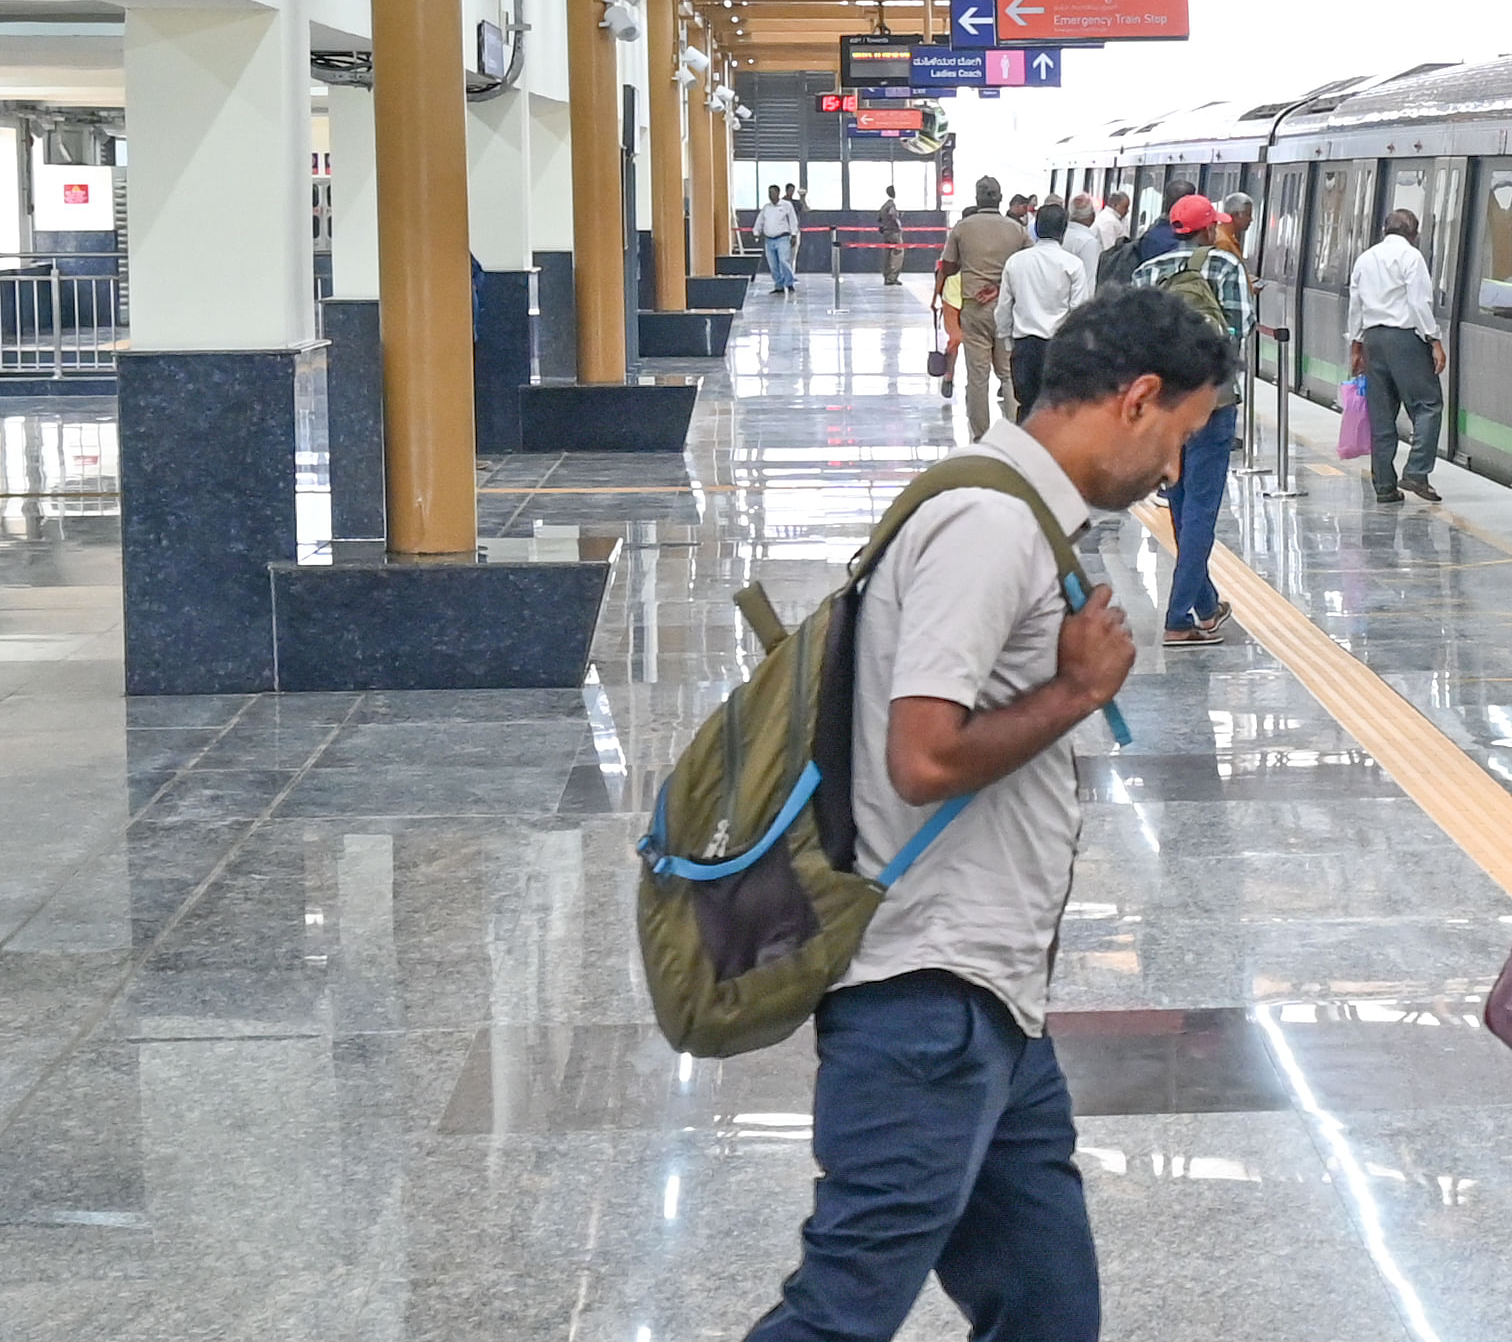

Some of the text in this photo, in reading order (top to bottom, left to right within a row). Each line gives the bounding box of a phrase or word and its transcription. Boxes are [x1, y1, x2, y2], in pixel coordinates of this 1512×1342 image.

[1054, 13, 1168, 27] Emergency Train Stop
[930, 69, 982, 78] Ladies Coach
